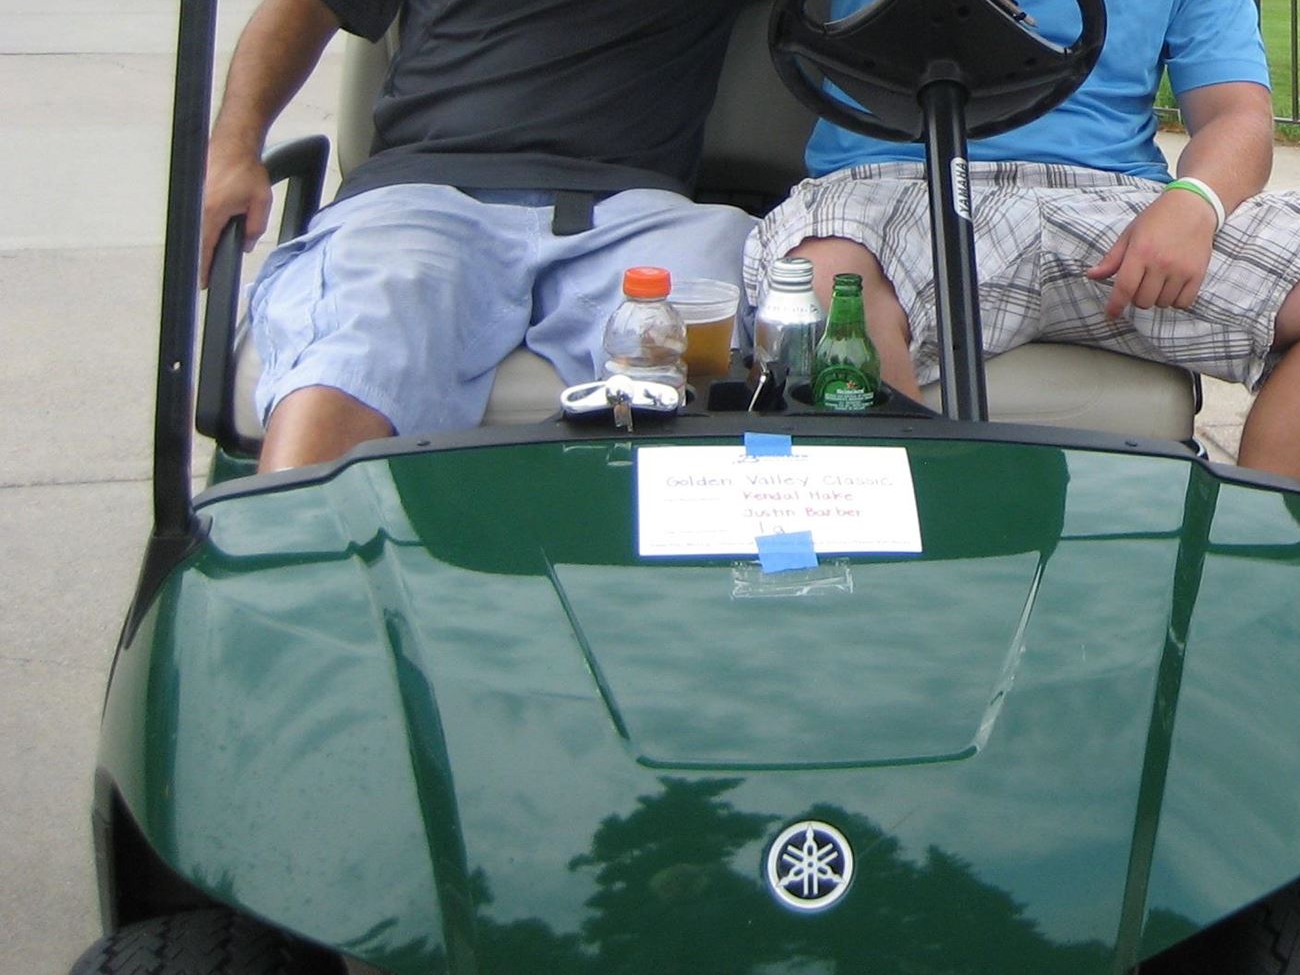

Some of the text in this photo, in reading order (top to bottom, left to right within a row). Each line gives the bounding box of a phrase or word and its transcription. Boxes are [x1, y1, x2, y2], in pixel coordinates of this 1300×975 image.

[955, 162, 970, 212] YAMAHA
[666, 475, 732, 487] Golden
[746, 475, 809, 487] Valley
[744, 508, 796, 518] Justin
